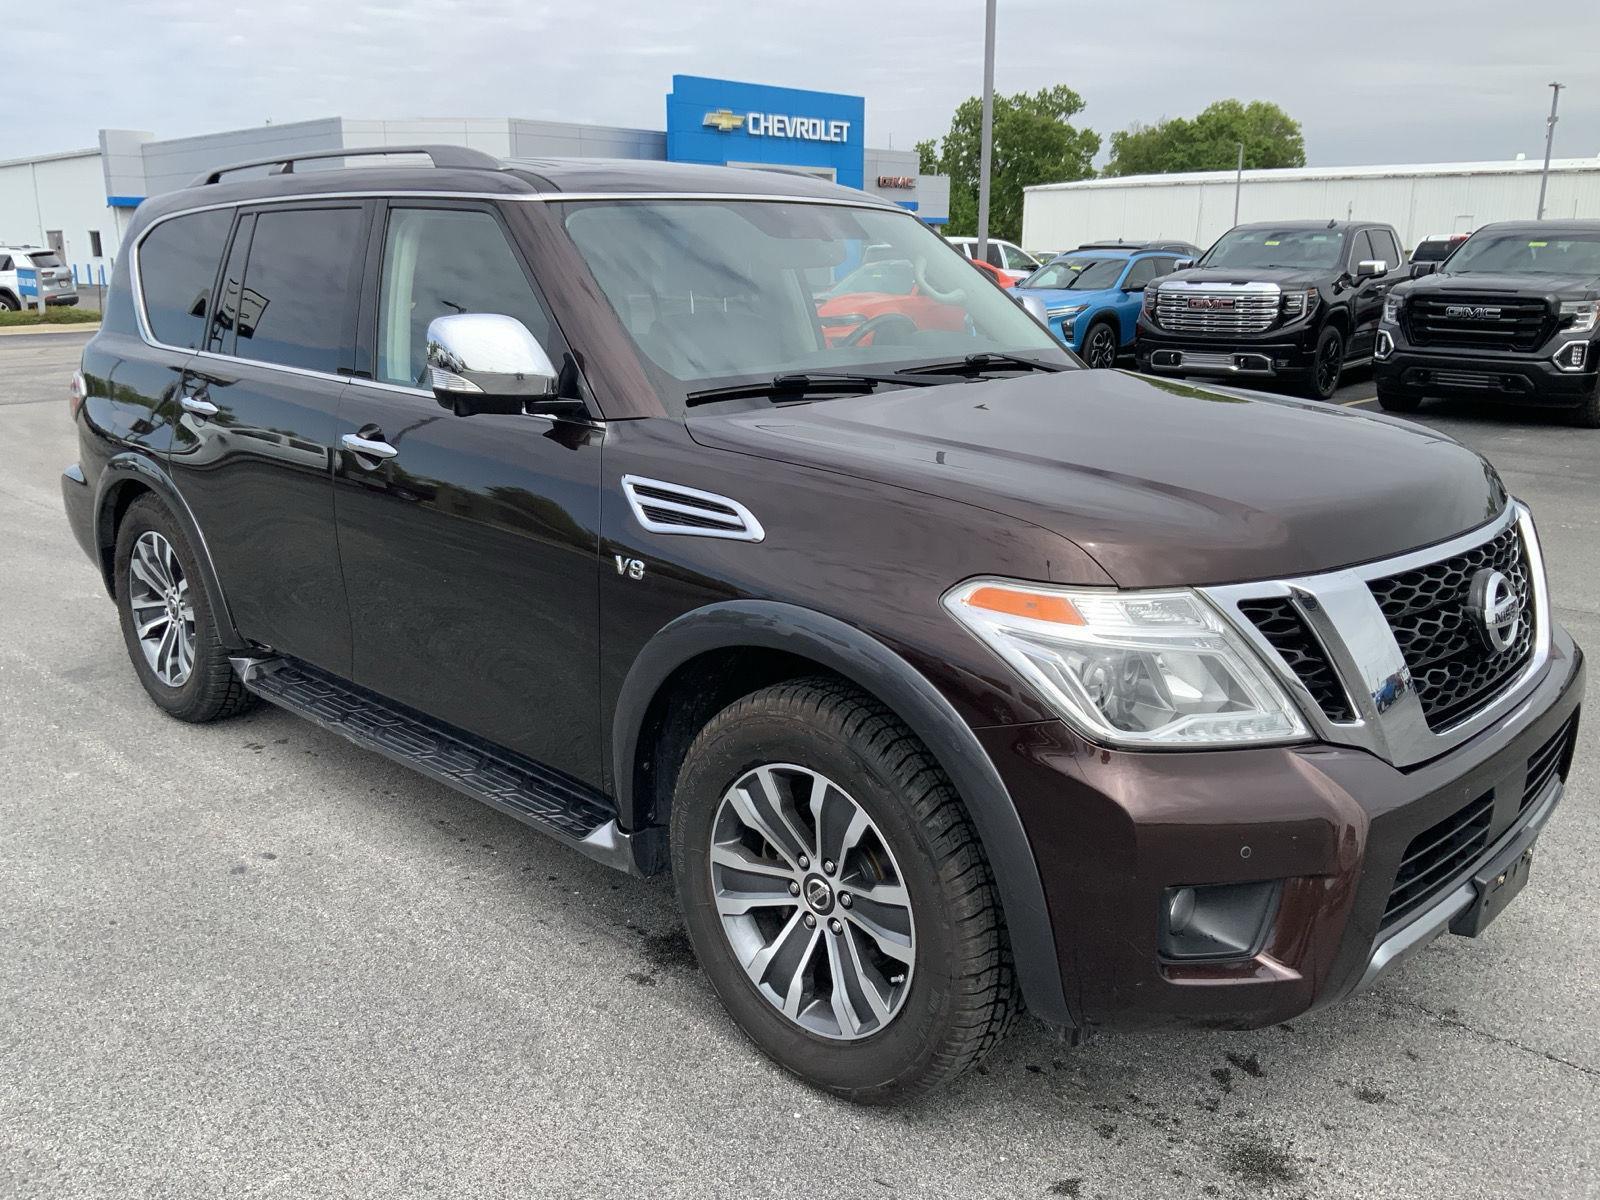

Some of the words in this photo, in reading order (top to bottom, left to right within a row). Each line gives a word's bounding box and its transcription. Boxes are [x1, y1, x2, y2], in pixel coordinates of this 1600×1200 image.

[747, 112, 850, 142] CHEVROLET
[1188, 298, 1235, 310] GMC
[1445, 306, 1501, 319] GMC
[615, 555, 645, 580] V8
